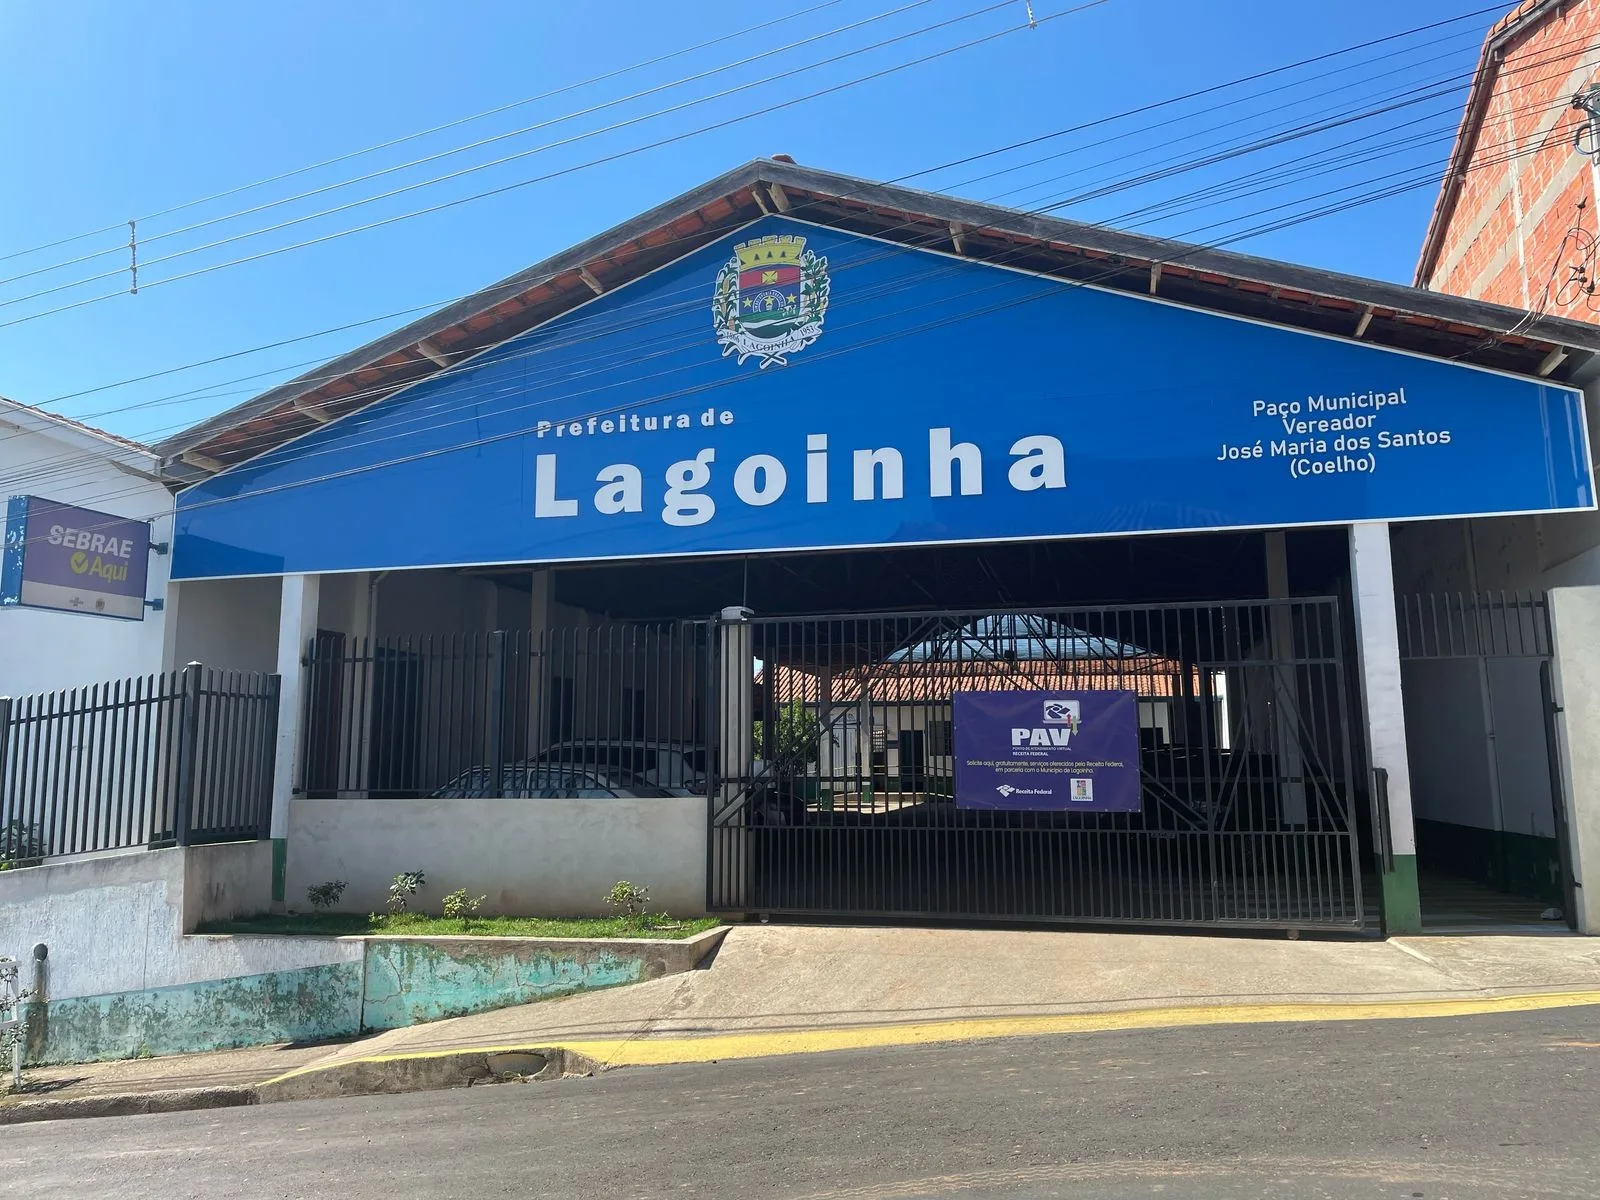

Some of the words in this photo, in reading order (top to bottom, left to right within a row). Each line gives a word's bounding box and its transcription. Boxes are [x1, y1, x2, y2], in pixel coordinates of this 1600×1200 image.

[800, 325, 815, 336] 1953
[1253, 399, 1301, 419] Paço
[1308, 387, 1407, 412] Municipal
[536, 412, 691, 438] Prefeitura
[700, 408, 735, 427] de
[1282, 413, 1377, 435] Vereador
[1216, 440, 1264, 461] José
[1270, 437, 1327, 457] Maria
[1334, 434, 1371, 452] dos
[1377, 429, 1451, 448] Santos
[534, 427, 1067, 527] Lagoinha
[1290, 452, 1376, 479] (Coelho)
[47, 524, 134, 559] SEBRAE
[88, 556, 129, 584] Aqui
[1011, 728, 1071, 746] PAV
